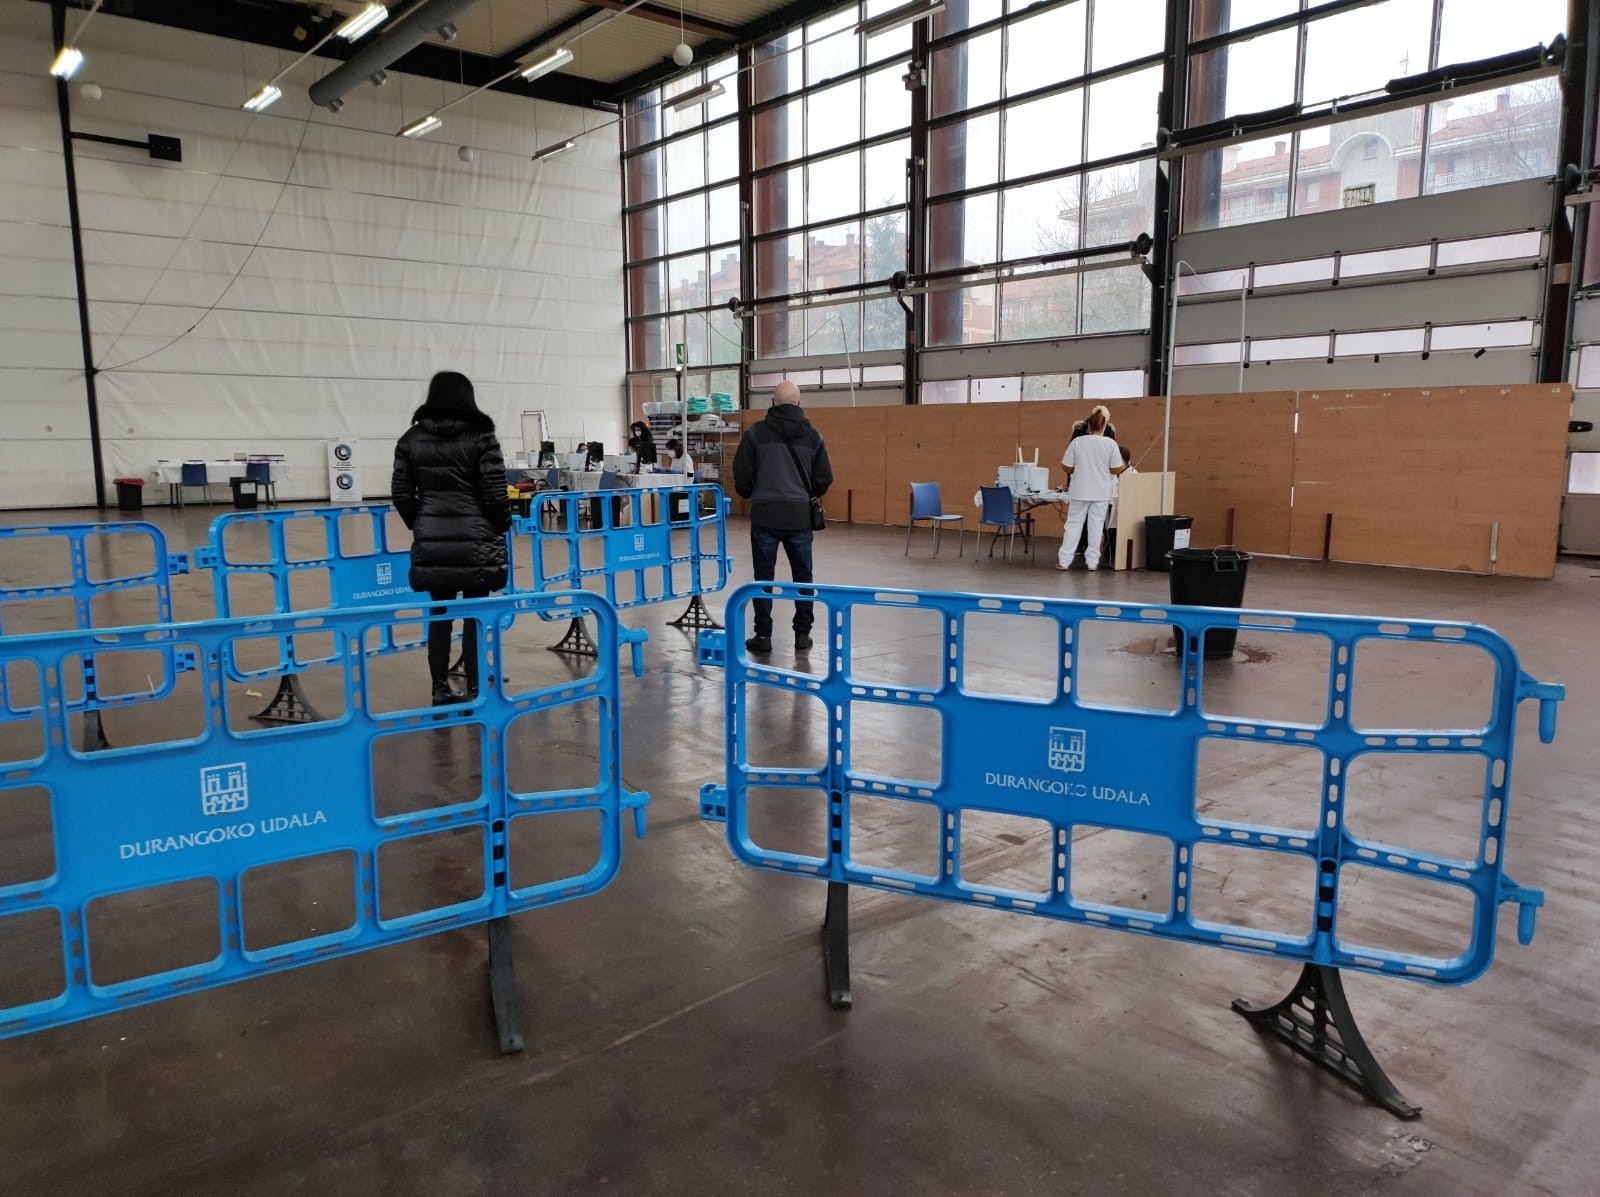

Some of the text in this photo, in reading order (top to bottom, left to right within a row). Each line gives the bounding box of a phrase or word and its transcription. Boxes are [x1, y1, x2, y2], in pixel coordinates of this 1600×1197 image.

[1092, 786, 1151, 806] UDALA
[119, 810, 328, 860] DURANGOKO UDALA
